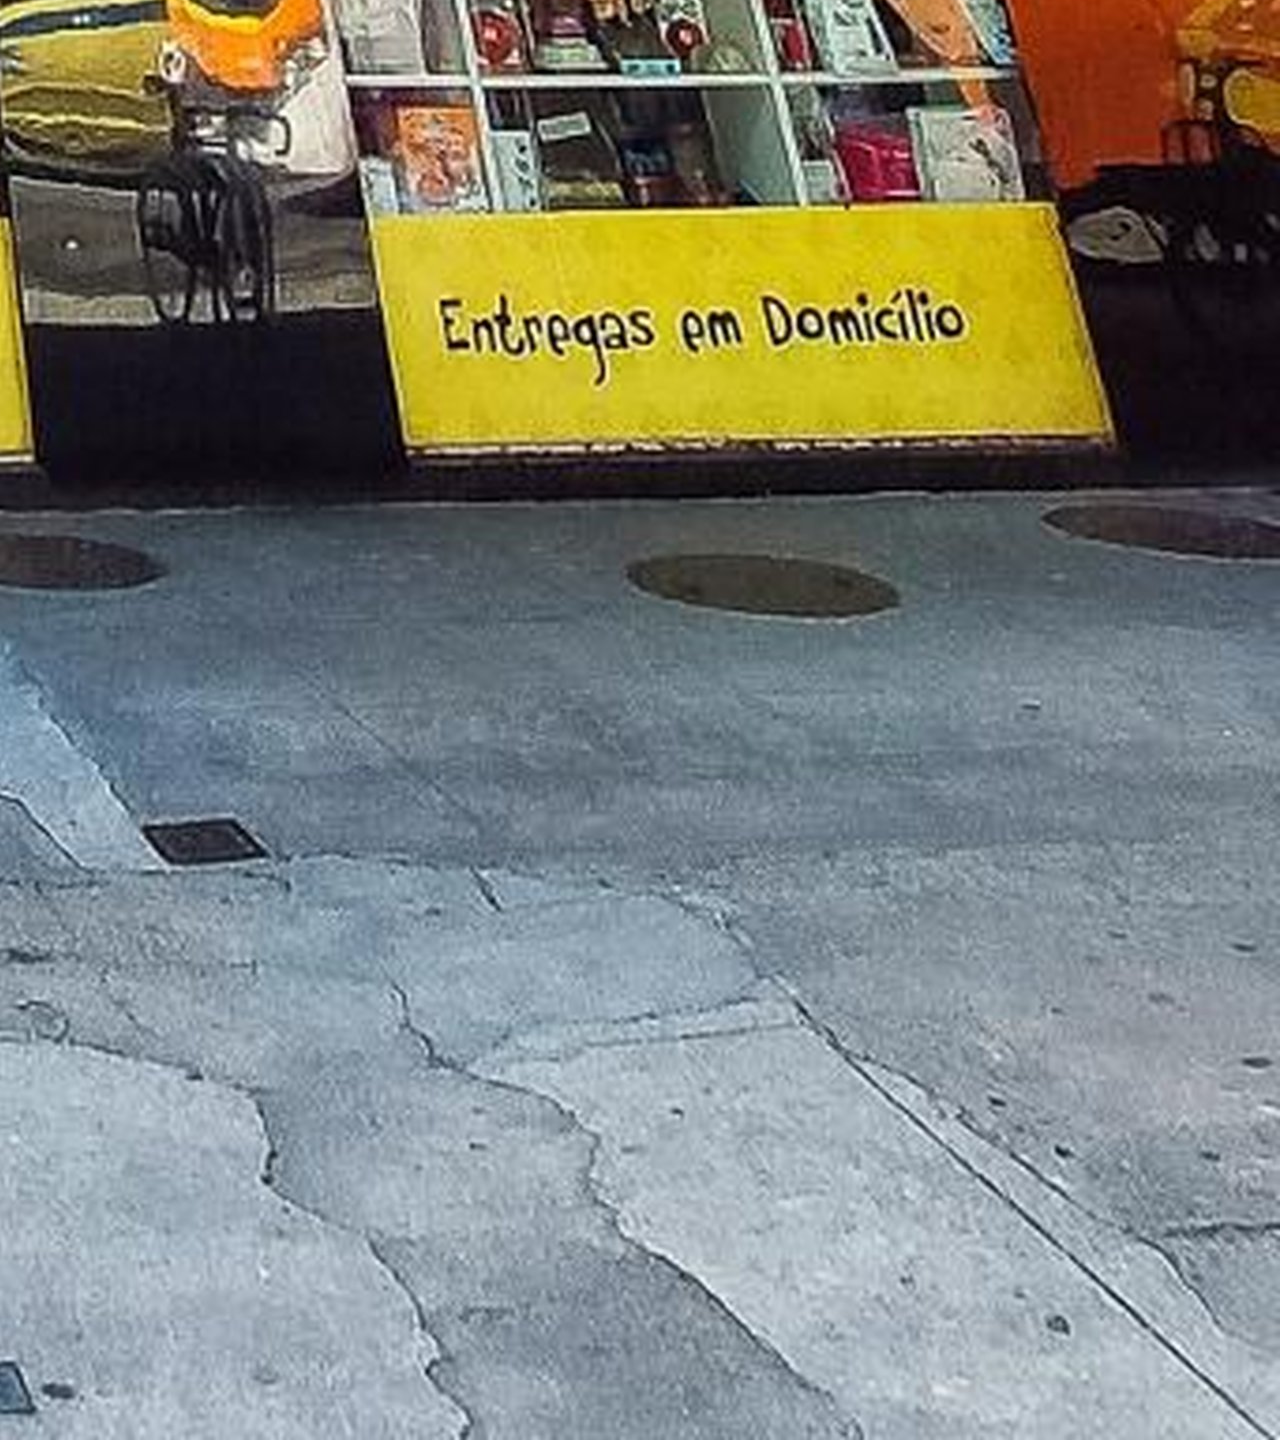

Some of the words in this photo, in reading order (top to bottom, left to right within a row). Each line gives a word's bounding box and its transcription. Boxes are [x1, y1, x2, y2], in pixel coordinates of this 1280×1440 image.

[440, 293, 655, 385] Entregas
[681, 313, 741, 353] em
[761, 288, 966, 348] Domicílio
